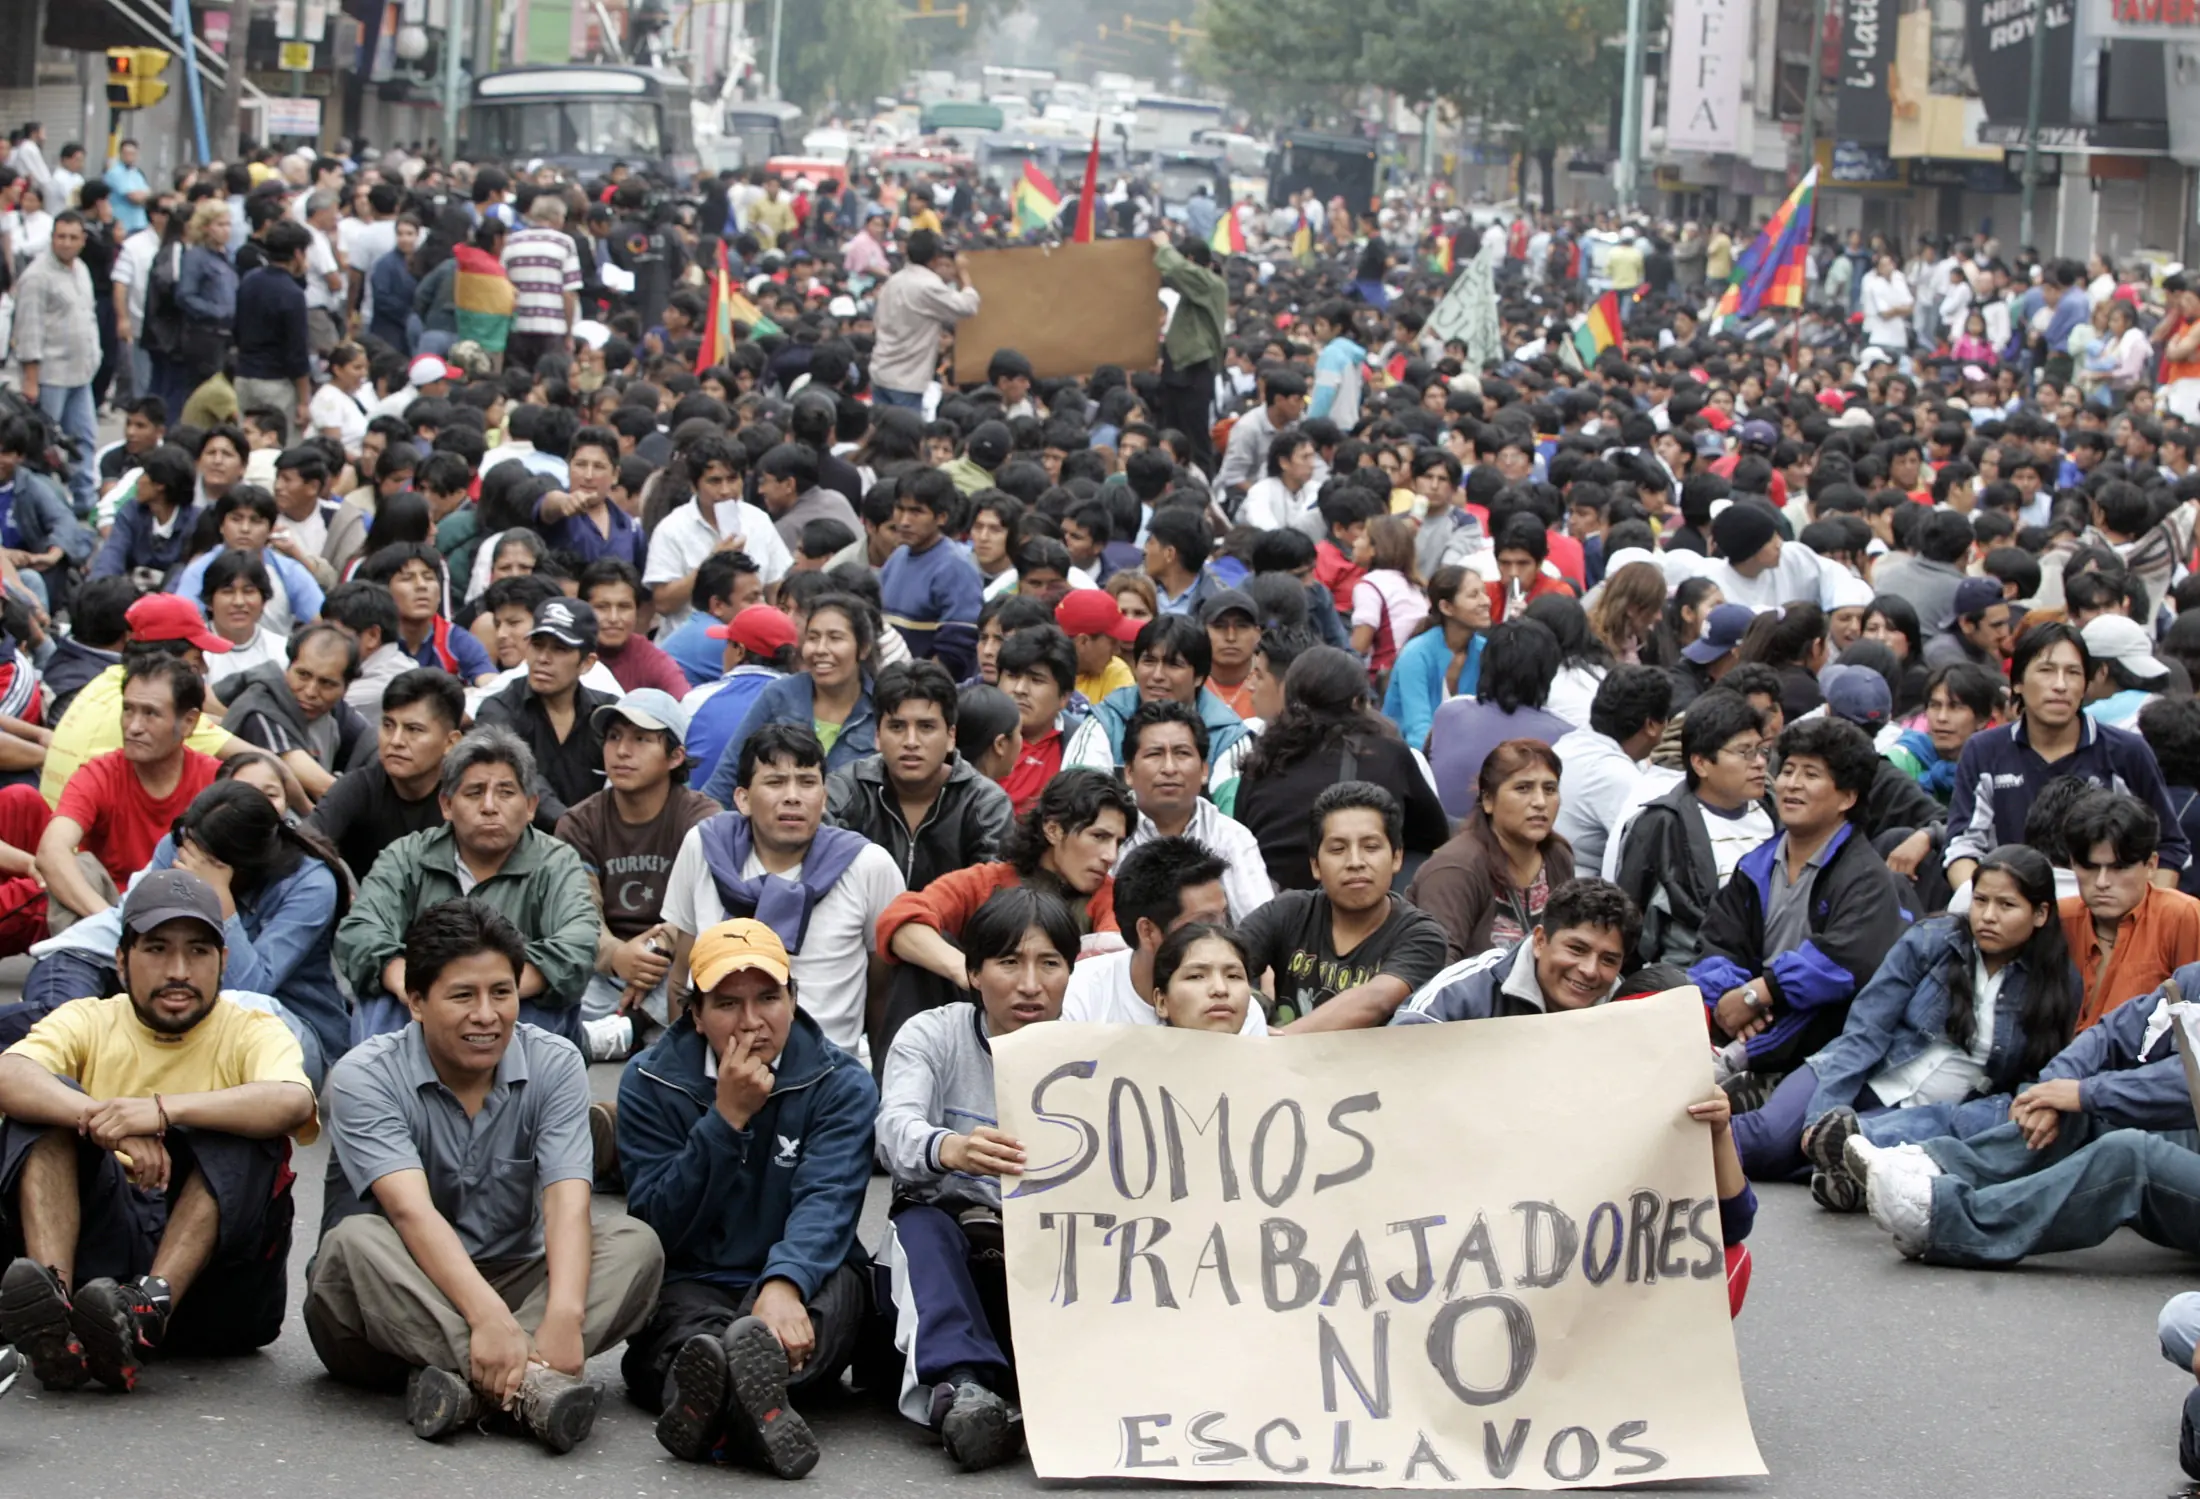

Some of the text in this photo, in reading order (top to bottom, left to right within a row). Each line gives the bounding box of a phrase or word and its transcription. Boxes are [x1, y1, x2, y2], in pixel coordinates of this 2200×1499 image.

[2111, 0, 2200, 25] TAVER
[605, 855, 671, 875] TURKEY
[1003, 1060, 1381, 1208] SOMOS
[1039, 1187, 1723, 1313] TRABAJADORES
[1317, 1293, 1538, 1419] NO
[1113, 1410, 1669, 1482] ESCLAVOS
